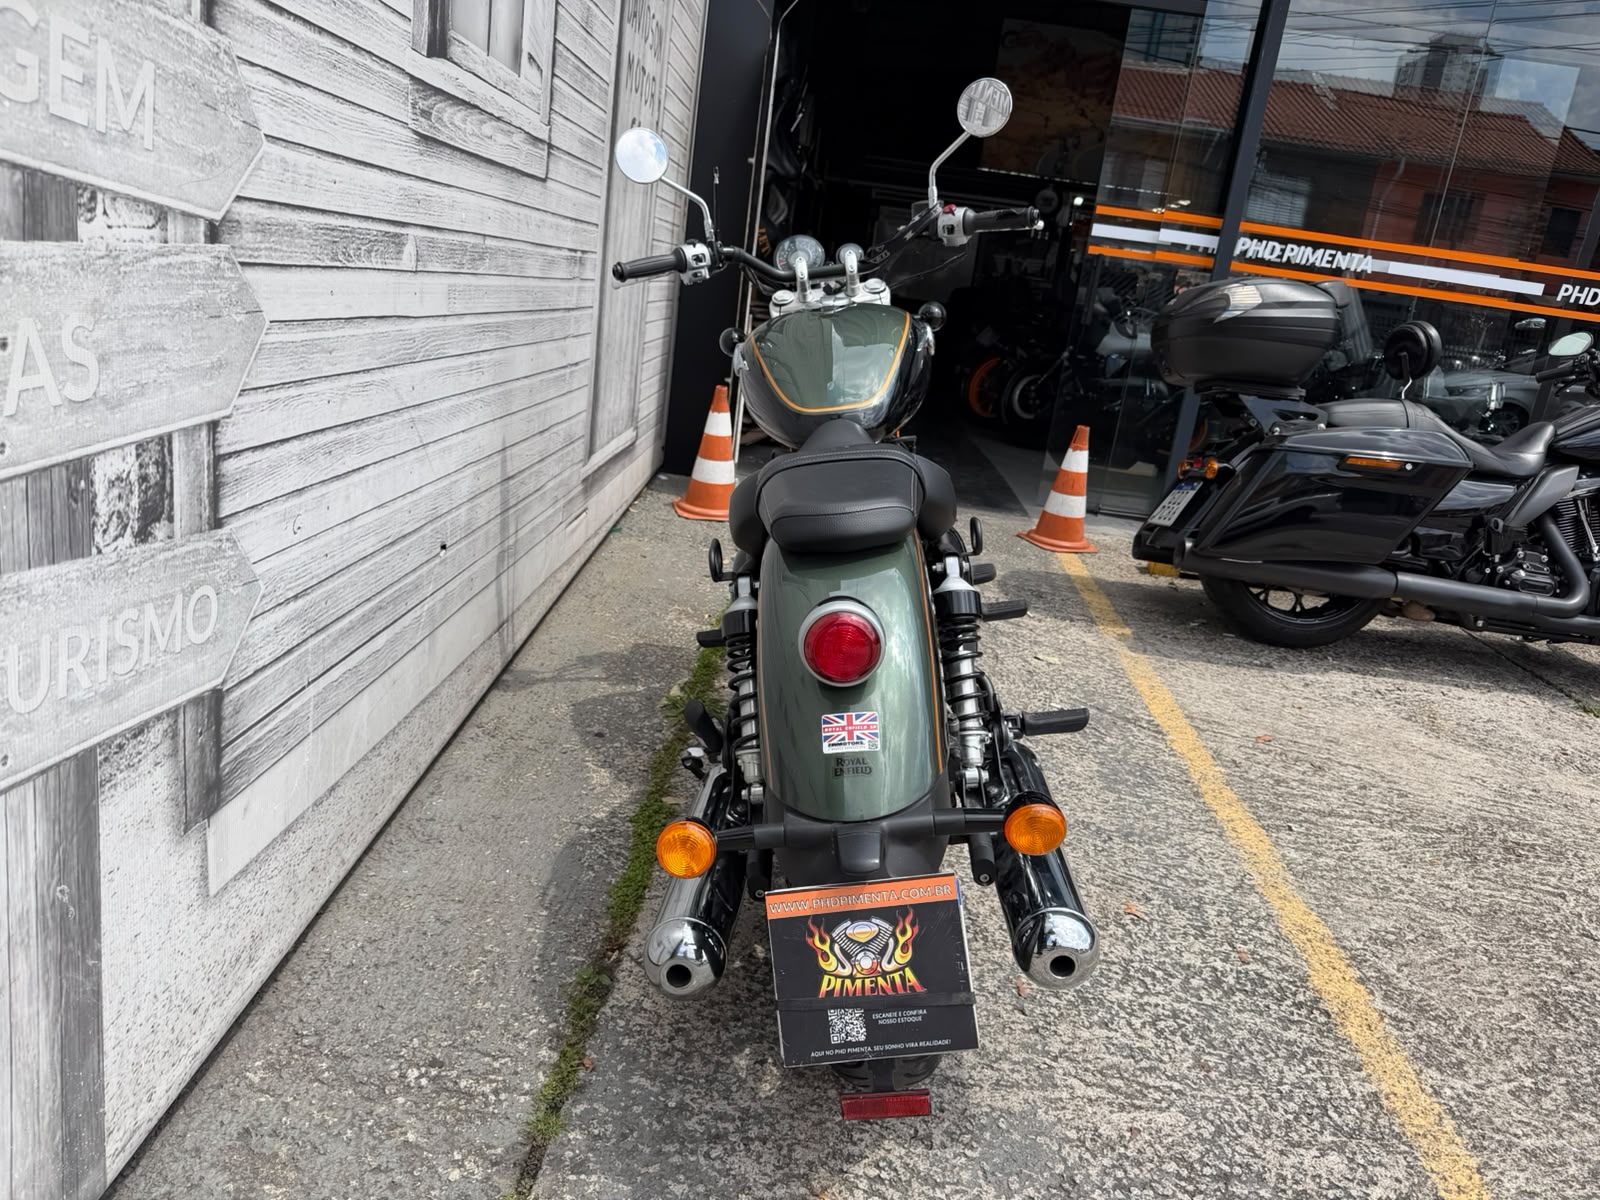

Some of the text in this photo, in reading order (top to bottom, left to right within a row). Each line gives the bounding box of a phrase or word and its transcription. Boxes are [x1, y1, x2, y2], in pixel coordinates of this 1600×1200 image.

[626, 50, 656, 116] MOTOR
[1282, 243, 1372, 273] PIMENTA
[1556, 283, 1600, 306] PHD
[3, 314, 99, 416] AS
[7, 585, 218, 713] URISMO
[834, 766, 873, 777] ENFIELD
[836, 757, 868, 767] ROYAL
[769, 884, 952, 914] WWW.PHDPIMENTA.COM.BR
[818, 966, 928, 998] PIMENTA
[902, 1009, 927, 1017] CONFIRA
